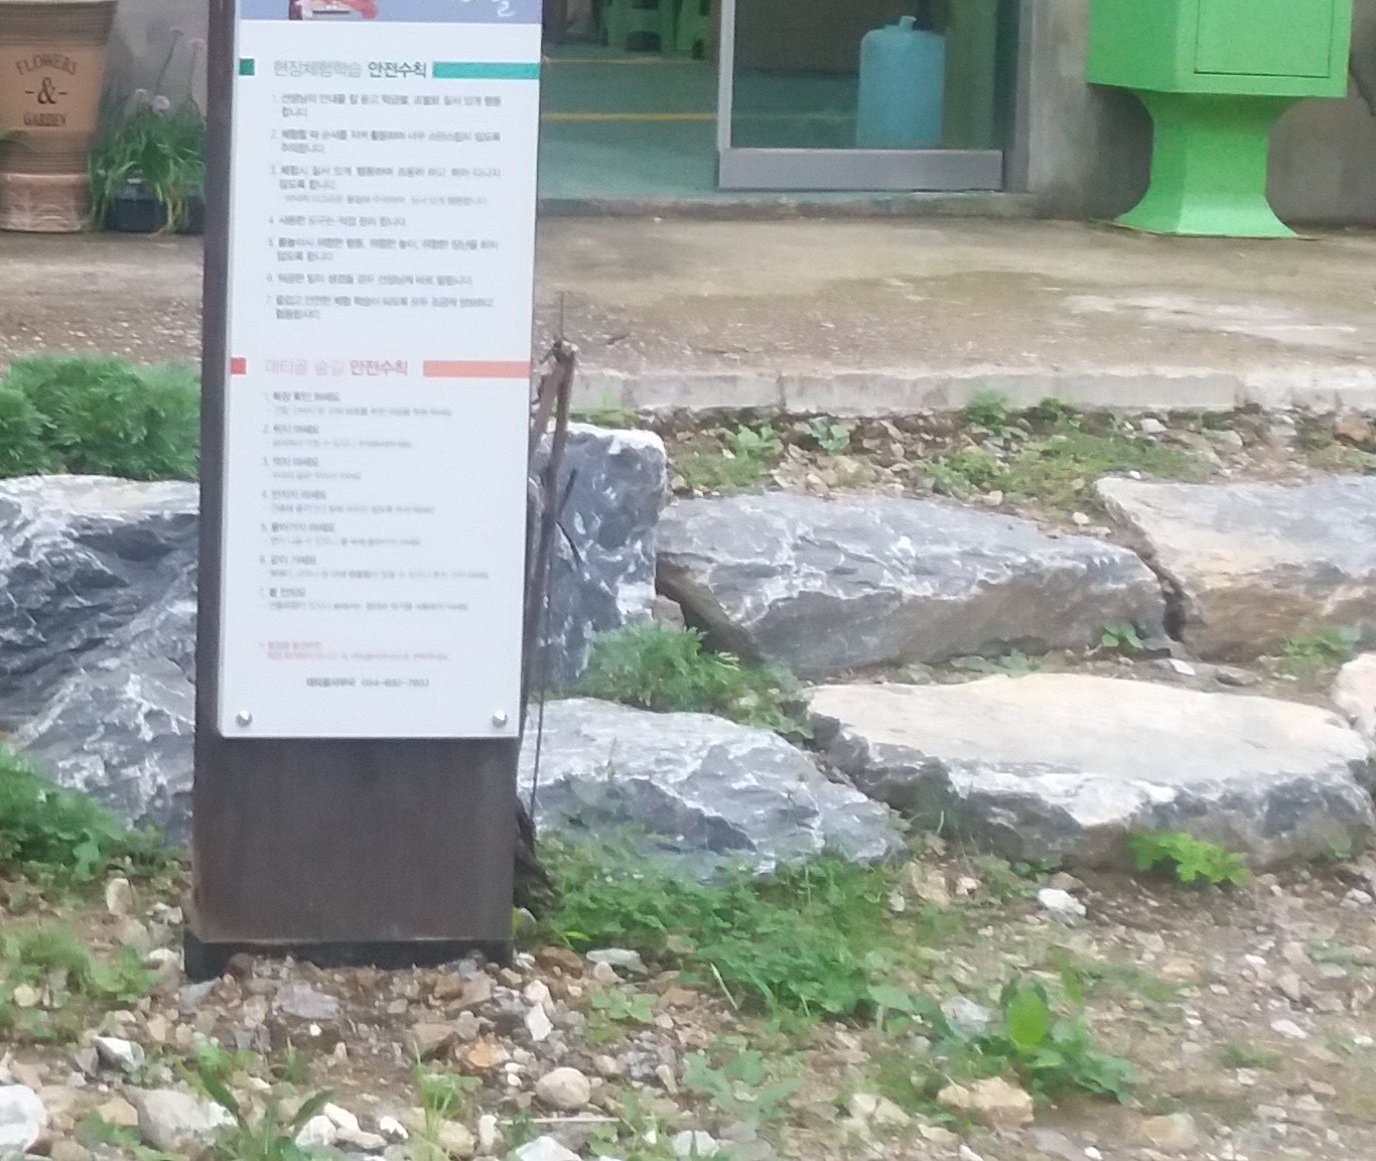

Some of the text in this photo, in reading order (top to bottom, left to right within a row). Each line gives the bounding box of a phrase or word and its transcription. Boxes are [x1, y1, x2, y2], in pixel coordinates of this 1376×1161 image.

[15, 52, 79, 76] FLOWERS
[367, 60, 427, 78] 안전수칙
[23, 111, 68, 127] GARDEN
[349, 358, 408, 377] 안전수칙
